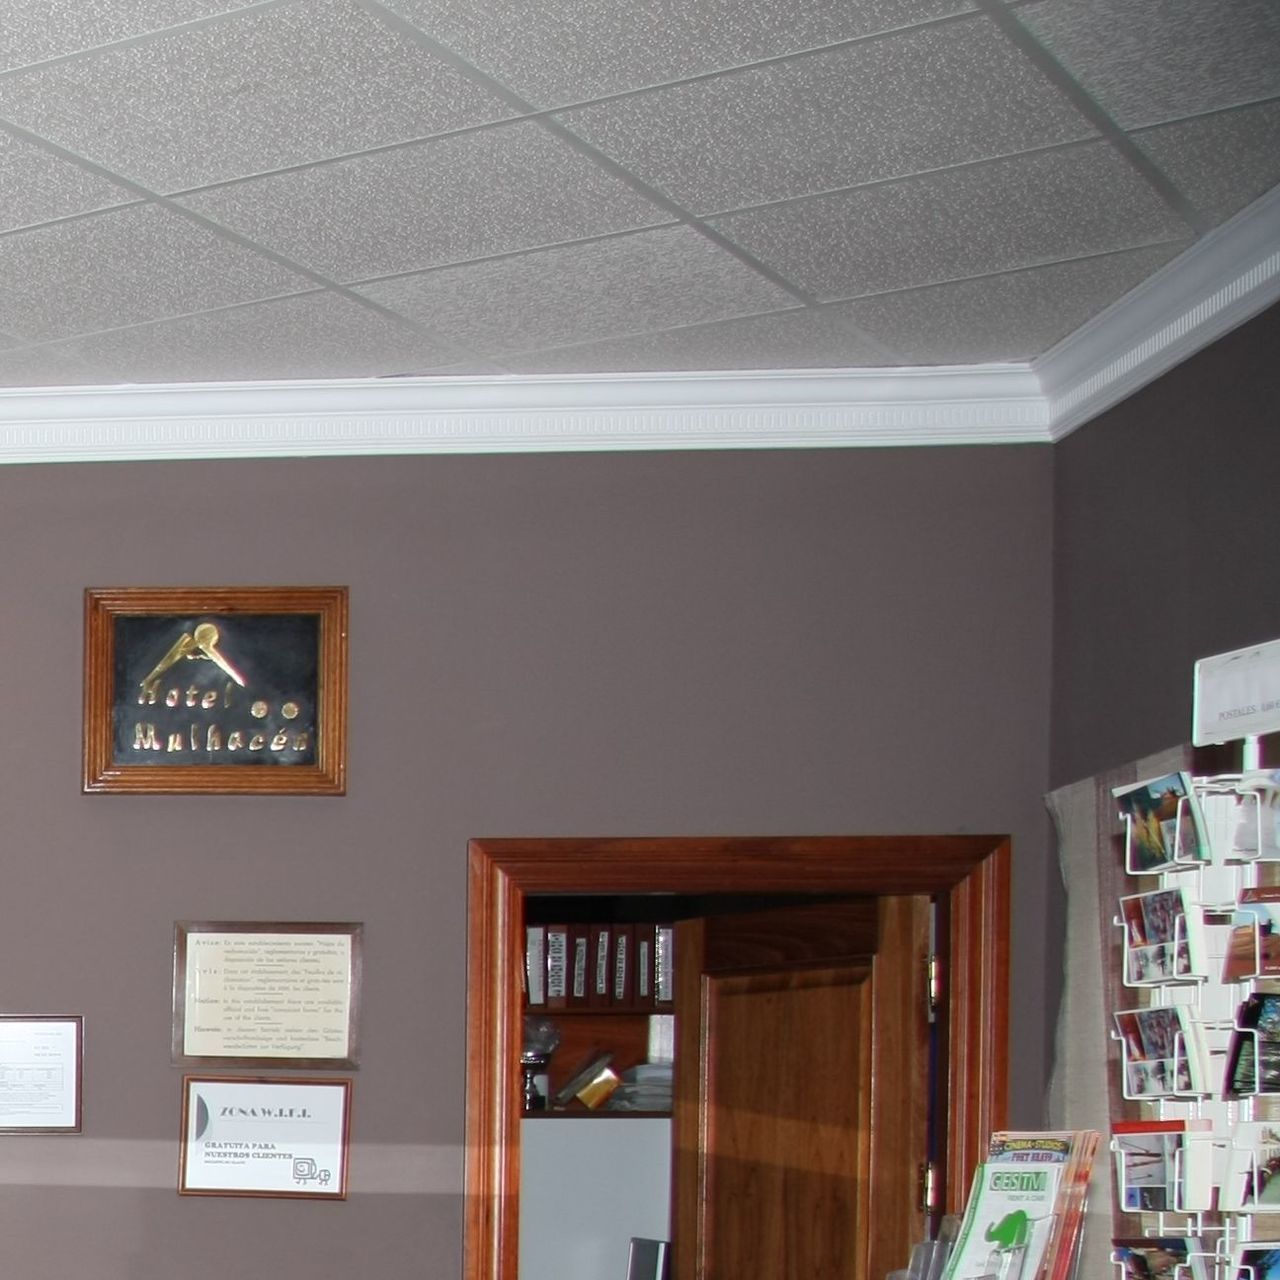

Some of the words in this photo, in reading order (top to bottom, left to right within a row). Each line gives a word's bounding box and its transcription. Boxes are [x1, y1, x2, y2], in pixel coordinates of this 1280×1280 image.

[138, 679, 233, 709] Hotel
[133, 721, 308, 752] Mulhacén
[204, 1141, 250, 1150] GRATUITA
[204, 1151, 250, 1159] NUESTROS
[251, 1152, 293, 1160] CLIENTES
